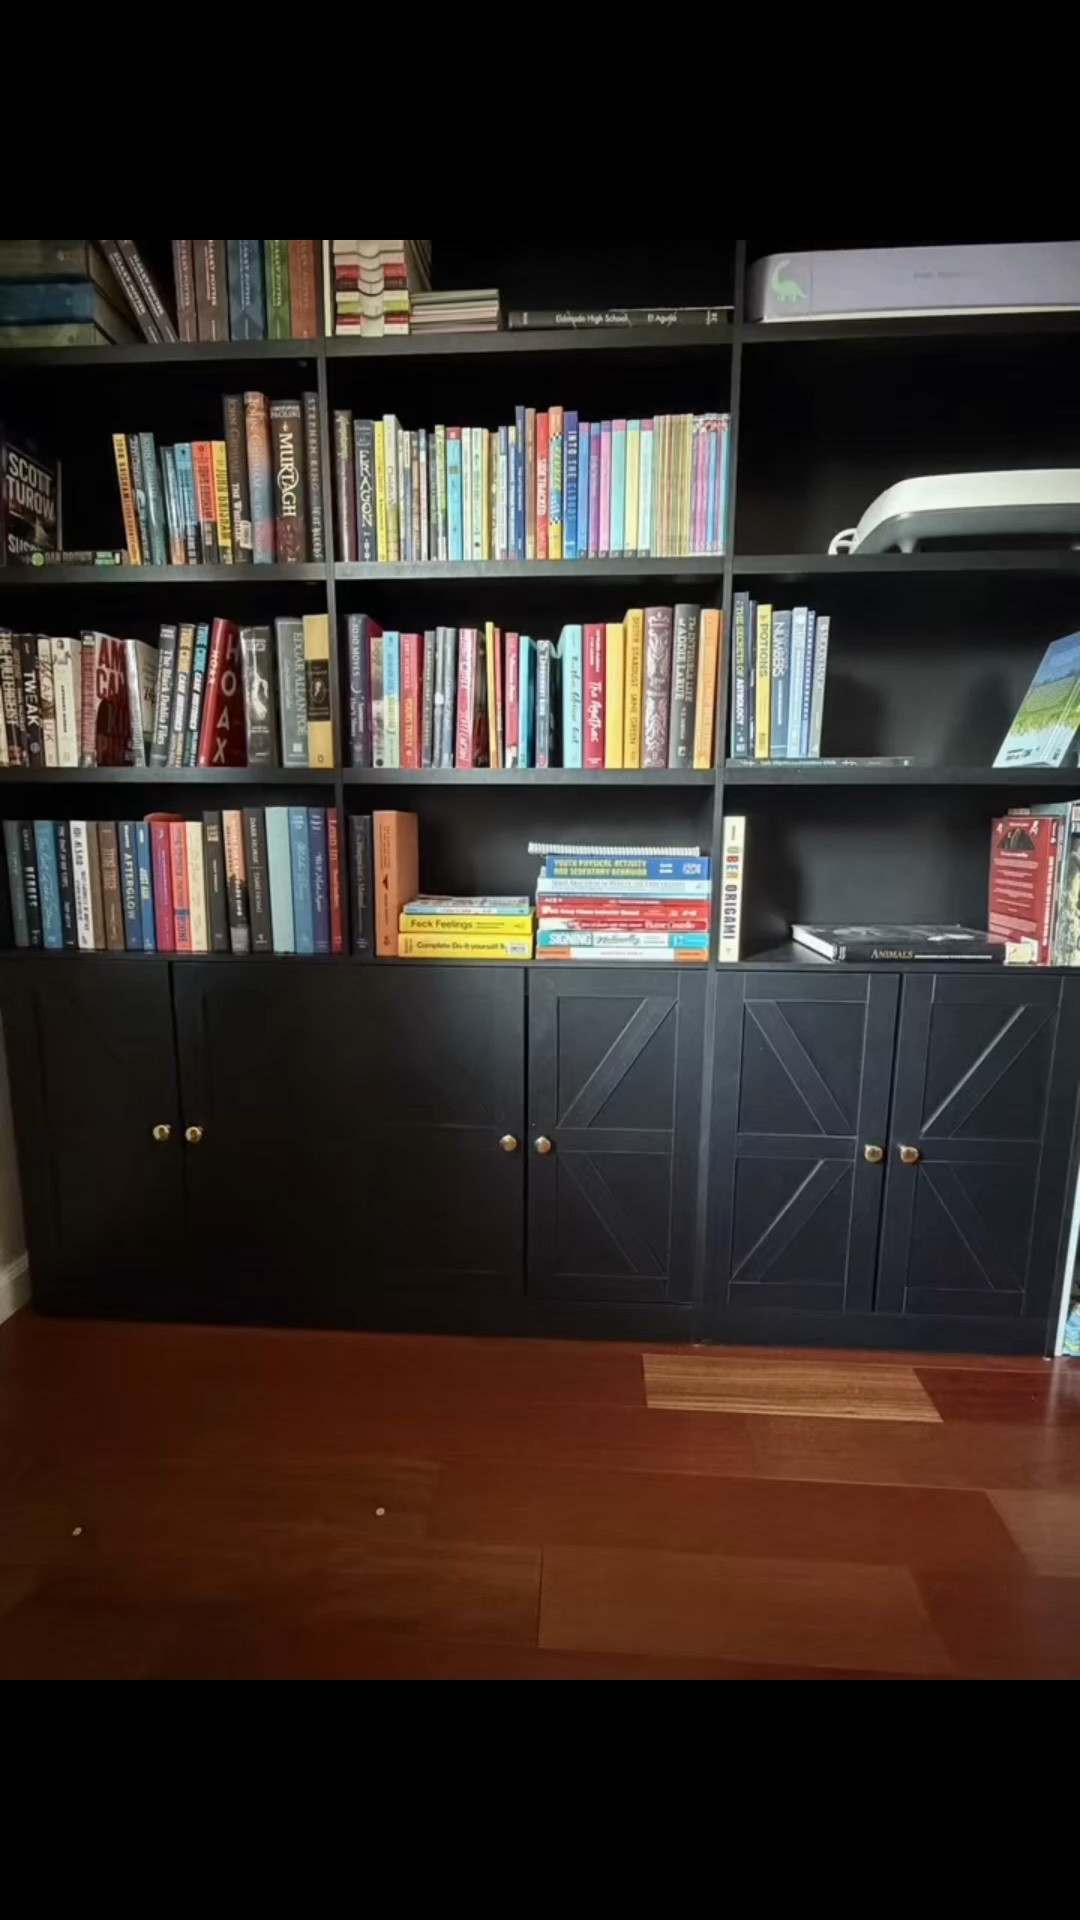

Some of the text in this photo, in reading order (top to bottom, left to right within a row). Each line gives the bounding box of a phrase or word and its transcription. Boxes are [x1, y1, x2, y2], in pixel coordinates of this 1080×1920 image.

[588, 313, 604, 324] High
[605, 313, 629, 323] School
[308, 398, 321, 492] STEPHEN KING
[6, 475, 54, 521] TUROW
[9, 453, 52, 496] SCOTT
[231, 483, 241, 499] THE
[277, 433, 299, 518] MURTAGH
[360, 449, 373, 528] ERAGON
[567, 431, 577, 521] INTO THE CLOUDS
[351, 623, 362, 677] JOJO MOYES
[677, 628, 688, 663] ADDIE
[686, 633, 697, 680] INVISIBLE
[736, 606, 744, 725] THE SECRETS OF ASTROLOGY
[758, 623, 770, 677] POTIONS
[772, 621, 785, 677] NUMBERS
[24, 670, 40, 726] TWEAK
[157, 650, 174, 745] The Black Dahlia Files
[212, 633, 240, 764] HOAX
[293, 631, 308, 737] EDGAR ALLAN POE
[587, 682, 603, 698] The
[629, 616, 641, 746] SISTER STARDUST JANE GREEN
[685, 681, 694, 703] LIFE
[587, 700, 603, 743] Agathas
[328, 819, 338, 846] Lean
[124, 852, 137, 920] AFTERGLOW
[554, 860, 647, 868] YOUTH PHYSICAL ACTIVITY
[554, 868, 648, 877] AND SEDENTARY BEHAVIOR
[436, 919, 473, 931] Feelings
[722, 884, 738, 941] ORIGAMI
[417, 942, 499, 951] Complete Do-it-yourself
[551, 934, 592, 945] SIGNING
[871, 949, 912, 960] ANIMALS
